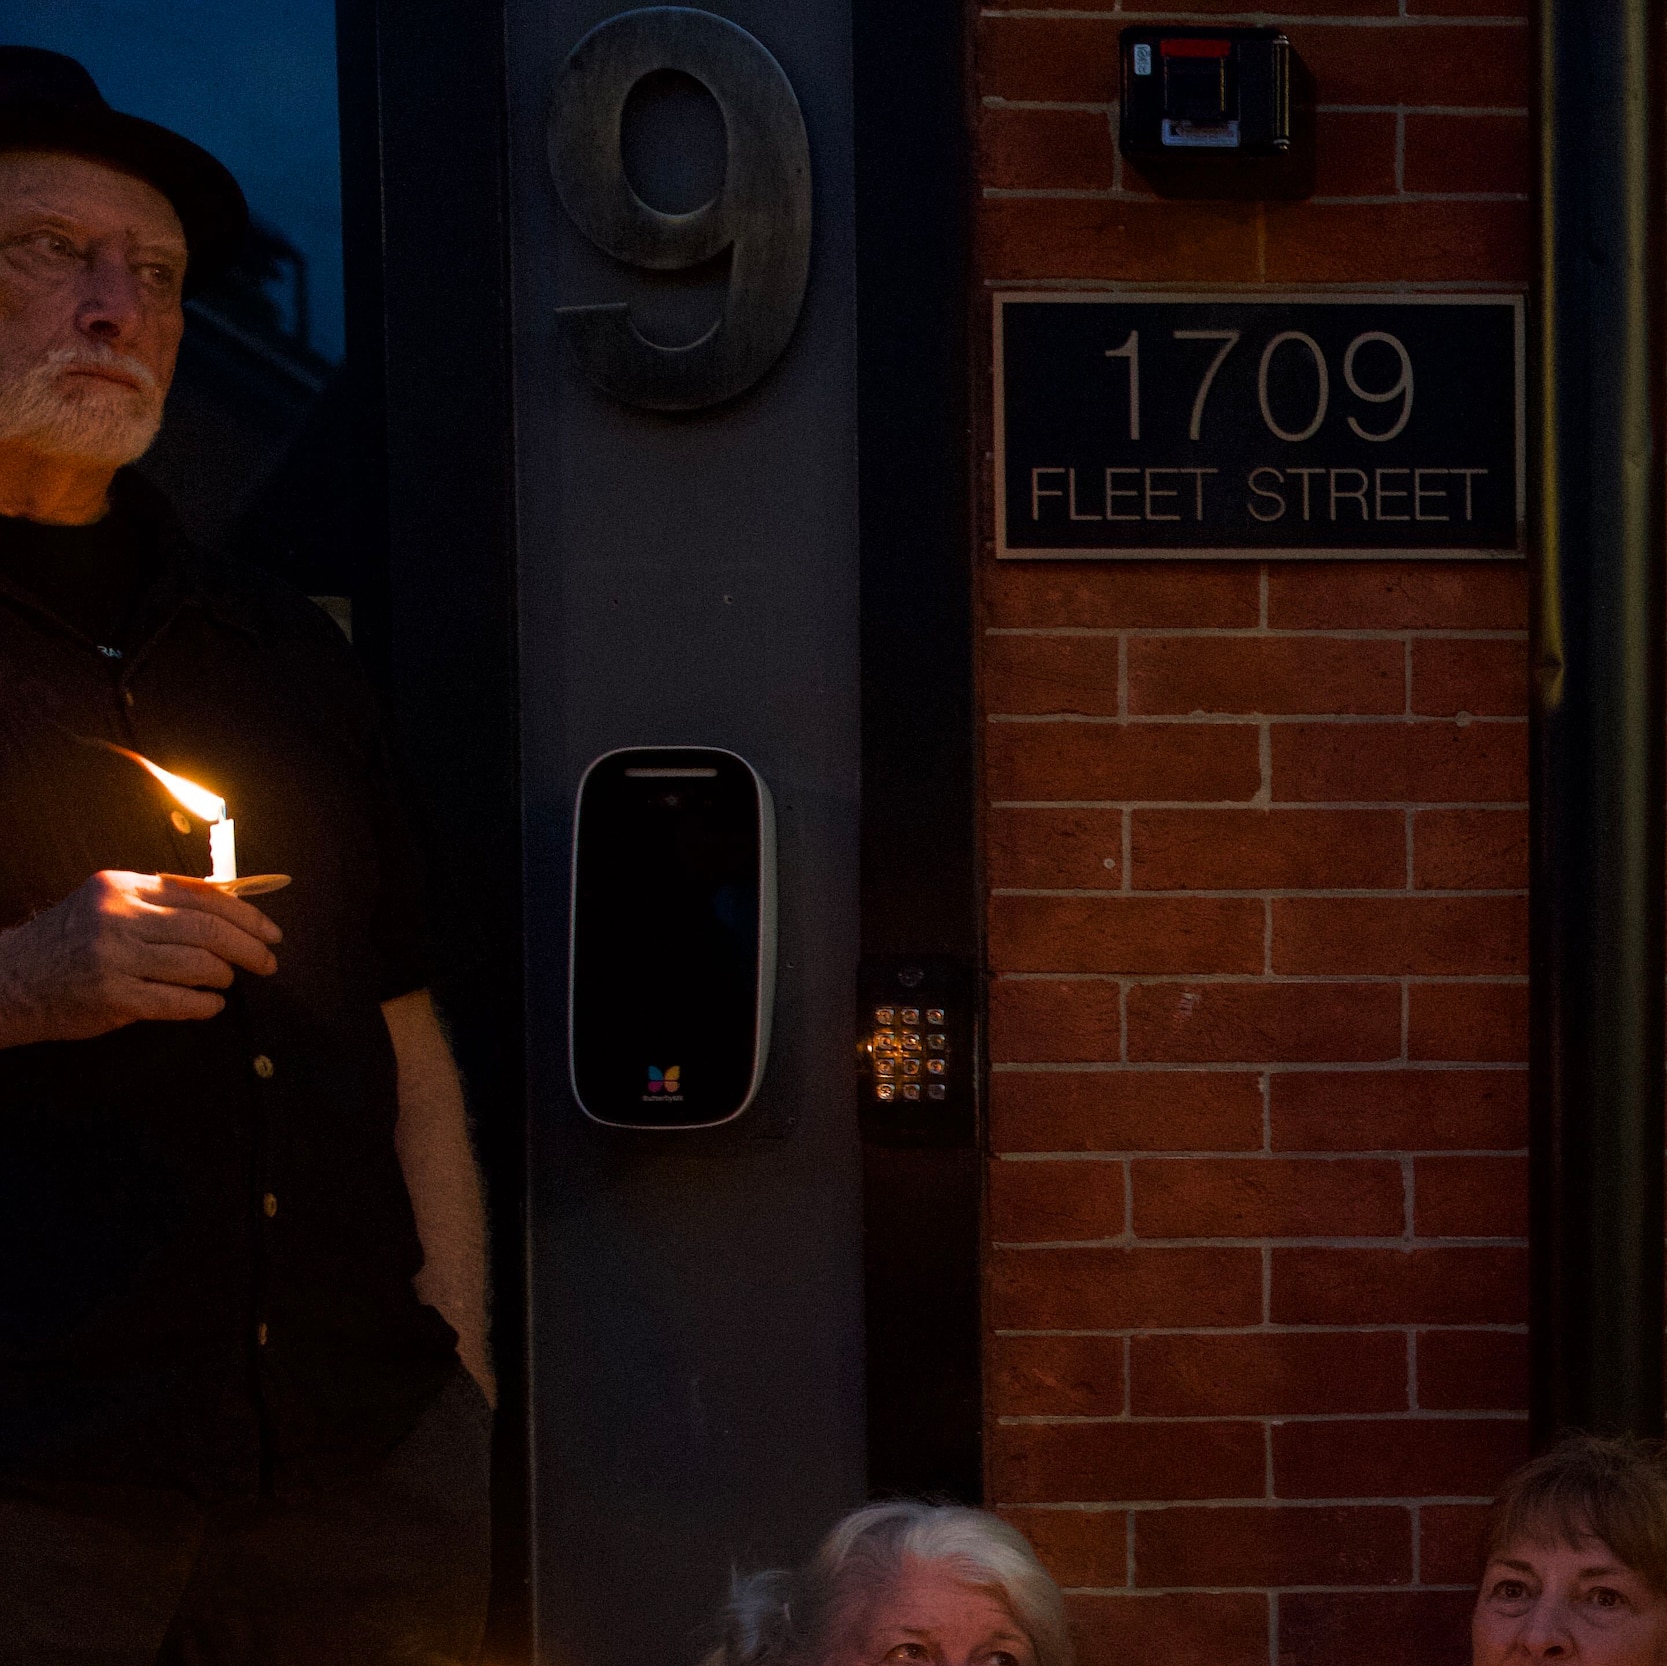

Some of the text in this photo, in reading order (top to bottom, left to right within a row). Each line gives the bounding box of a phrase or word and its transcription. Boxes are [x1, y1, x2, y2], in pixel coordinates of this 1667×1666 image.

[547, 5, 813, 412] 9
[1104, 329, 1414, 442] 1709
[1031, 466, 1489, 522] FLEET STREET
